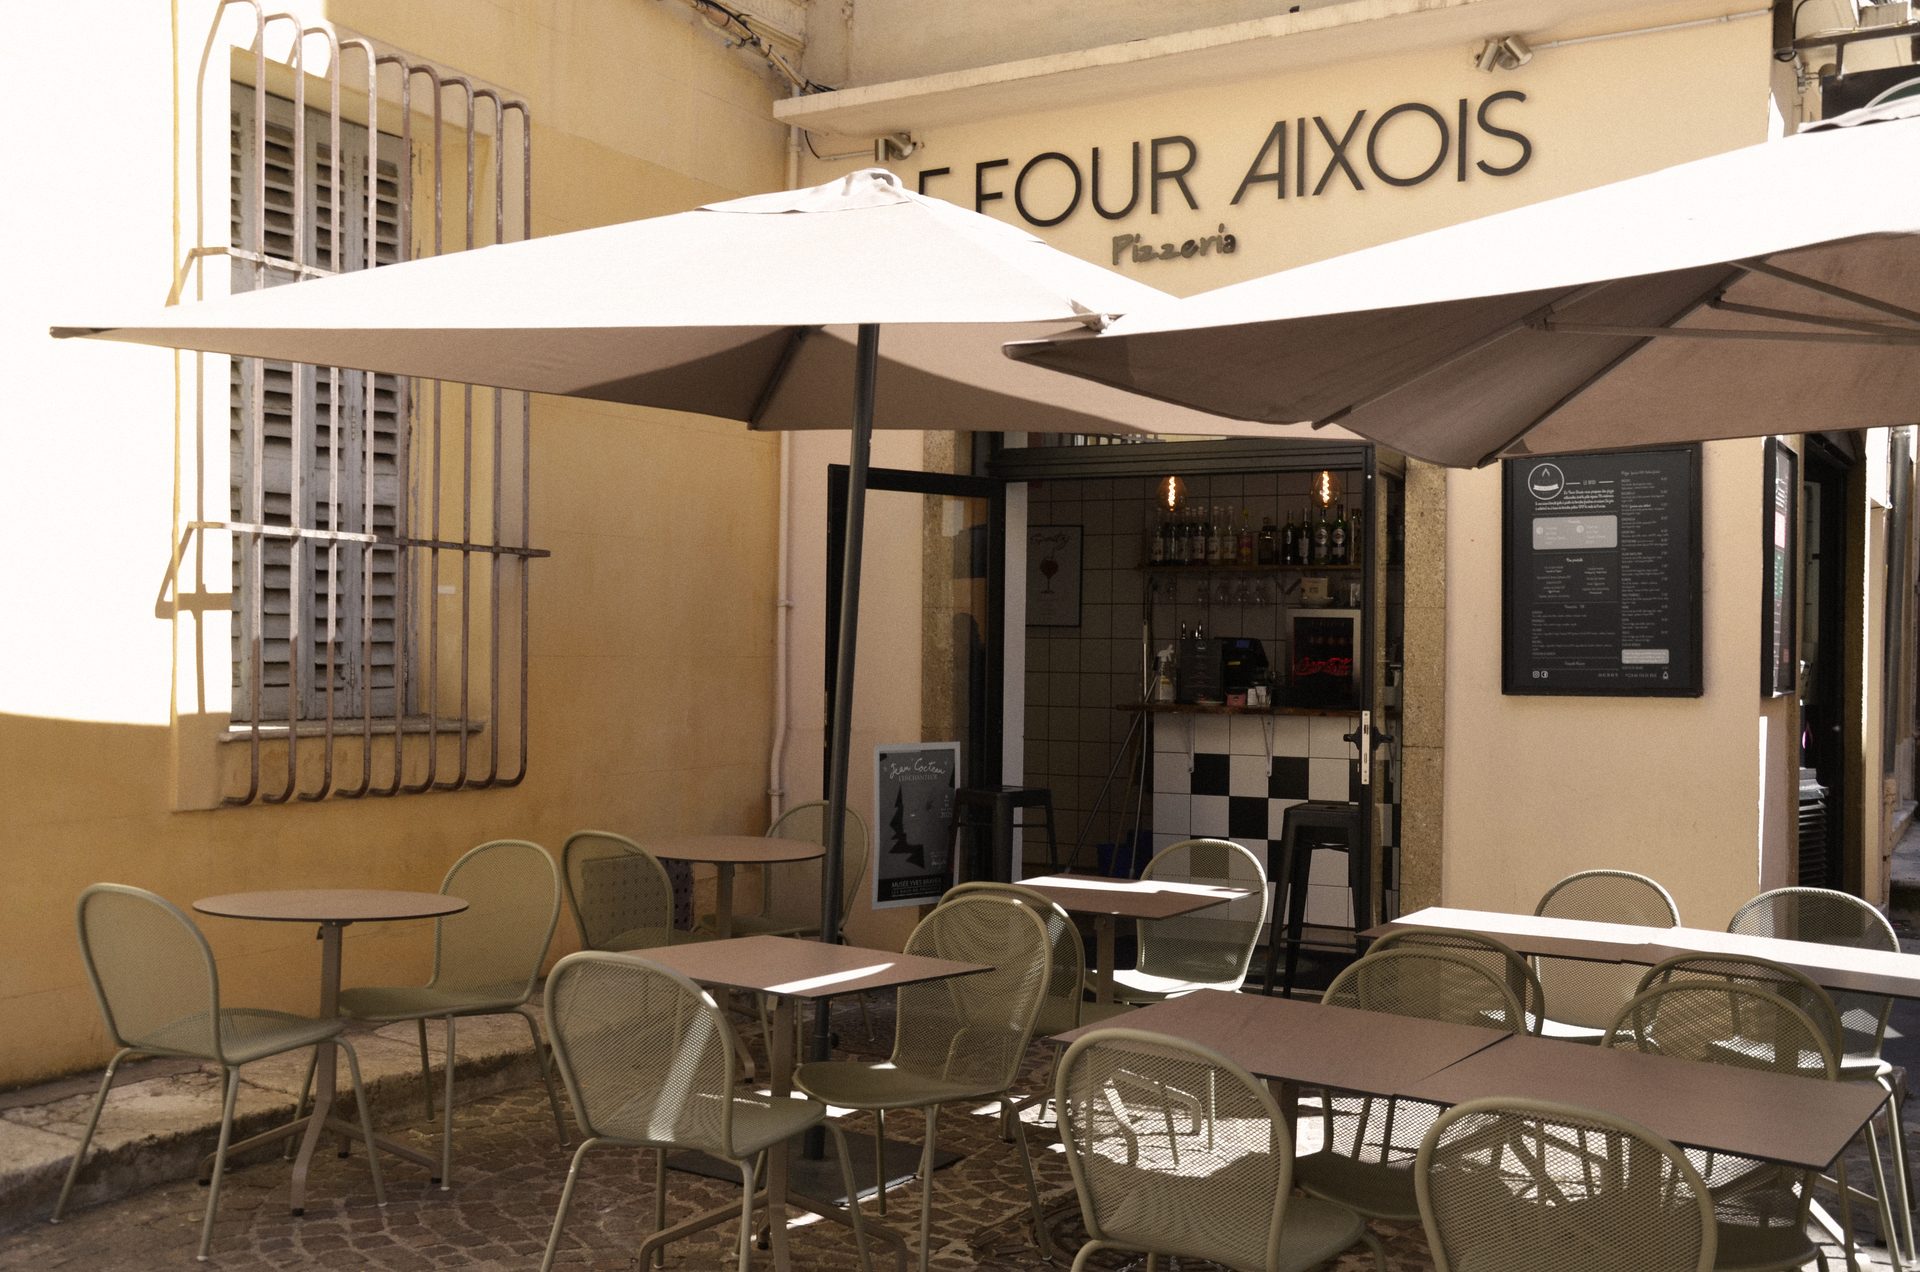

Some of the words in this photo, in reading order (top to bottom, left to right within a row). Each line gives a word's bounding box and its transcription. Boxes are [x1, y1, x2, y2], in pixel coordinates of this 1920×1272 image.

[976, 136, 1199, 228] FOUR
[1230, 90, 1533, 205] AIXOIS
[1112, 223, 1237, 265] Pizzeria
